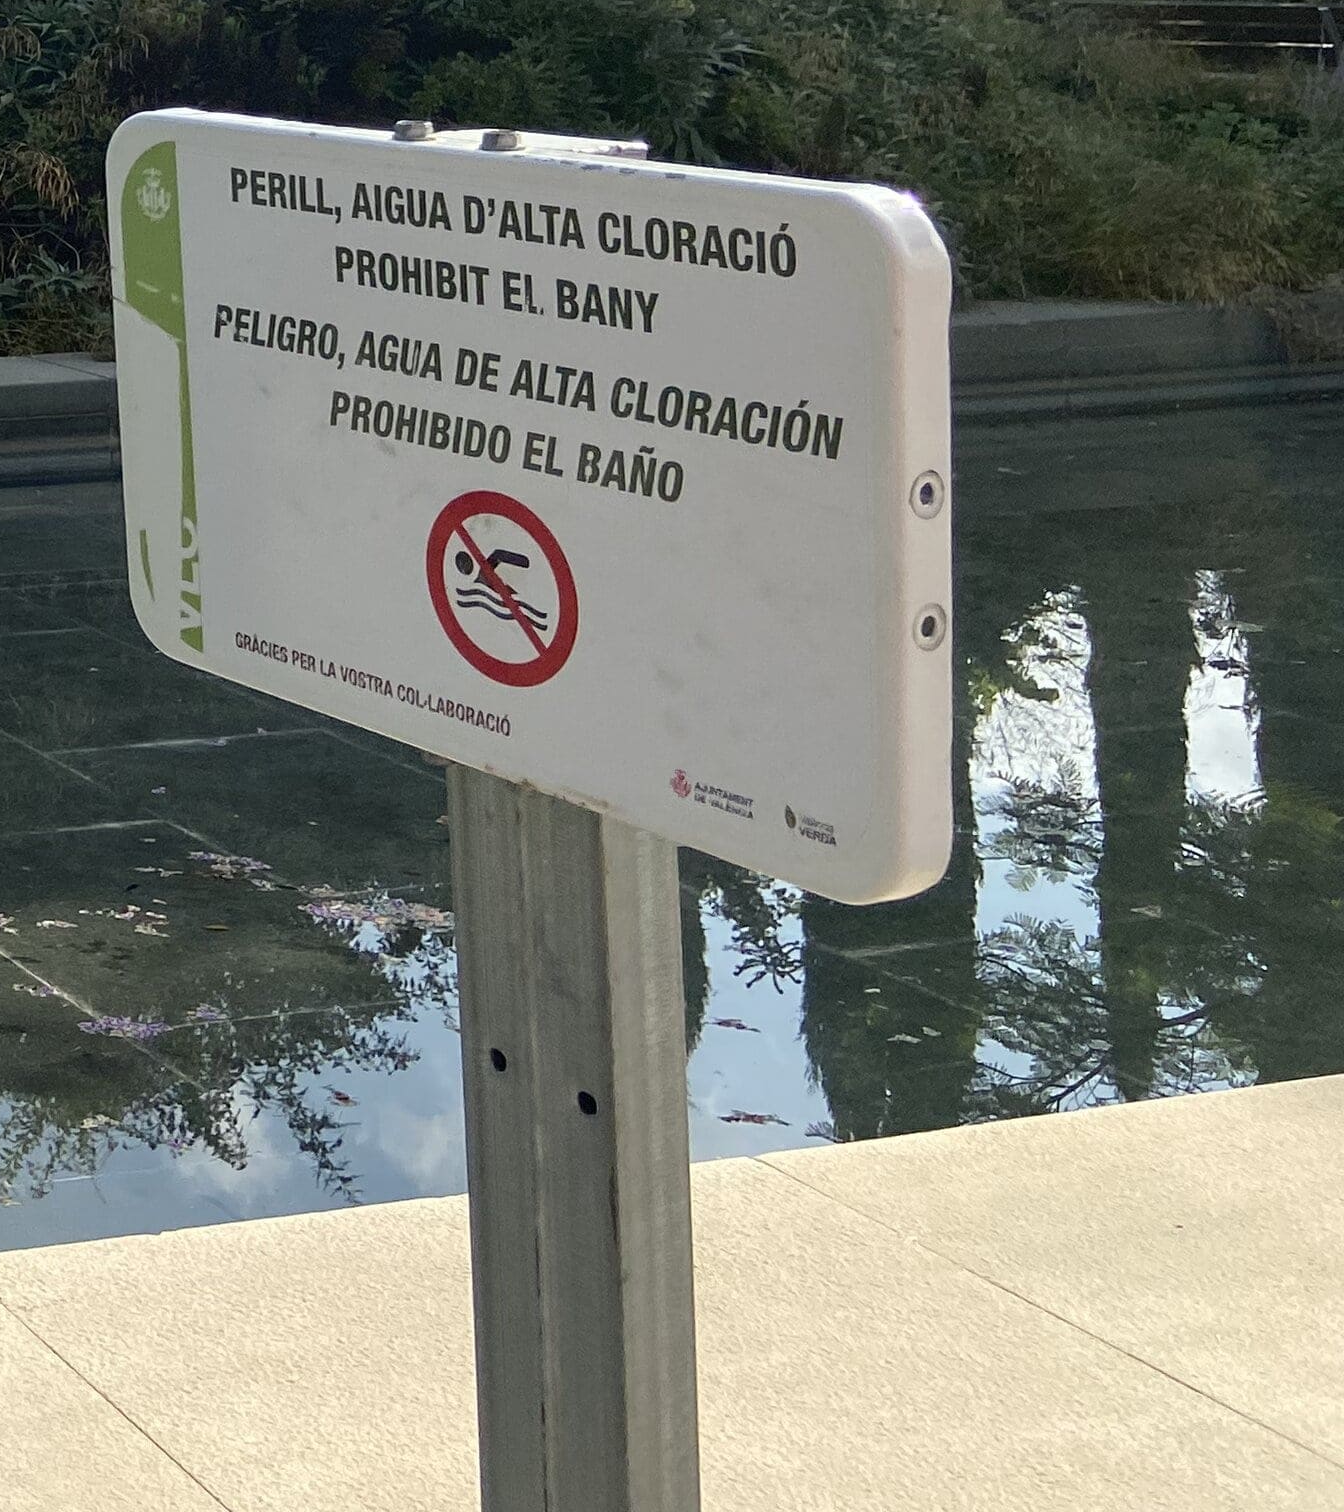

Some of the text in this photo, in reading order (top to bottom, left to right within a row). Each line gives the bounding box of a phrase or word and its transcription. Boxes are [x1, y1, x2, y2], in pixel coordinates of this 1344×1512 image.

[230, 167, 342, 224] PERILL,
[351, 182, 452, 231] AIGUA
[598, 211, 797, 278] CLORACIÓ
[335, 246, 489, 305] PROHIBIT
[556, 278, 659, 333] BANY
[214, 304, 844, 460] PELIGRO, AGUA DE ALTA CLORACIÓN
[330, 391, 685, 503] PROHIBIDO EL BAÑO
[235, 631, 288, 663] GRÀCIES
[292, 650, 316, 672] PER
[320, 660, 336, 678] LA
[340, 665, 393, 698] VOSTRA
